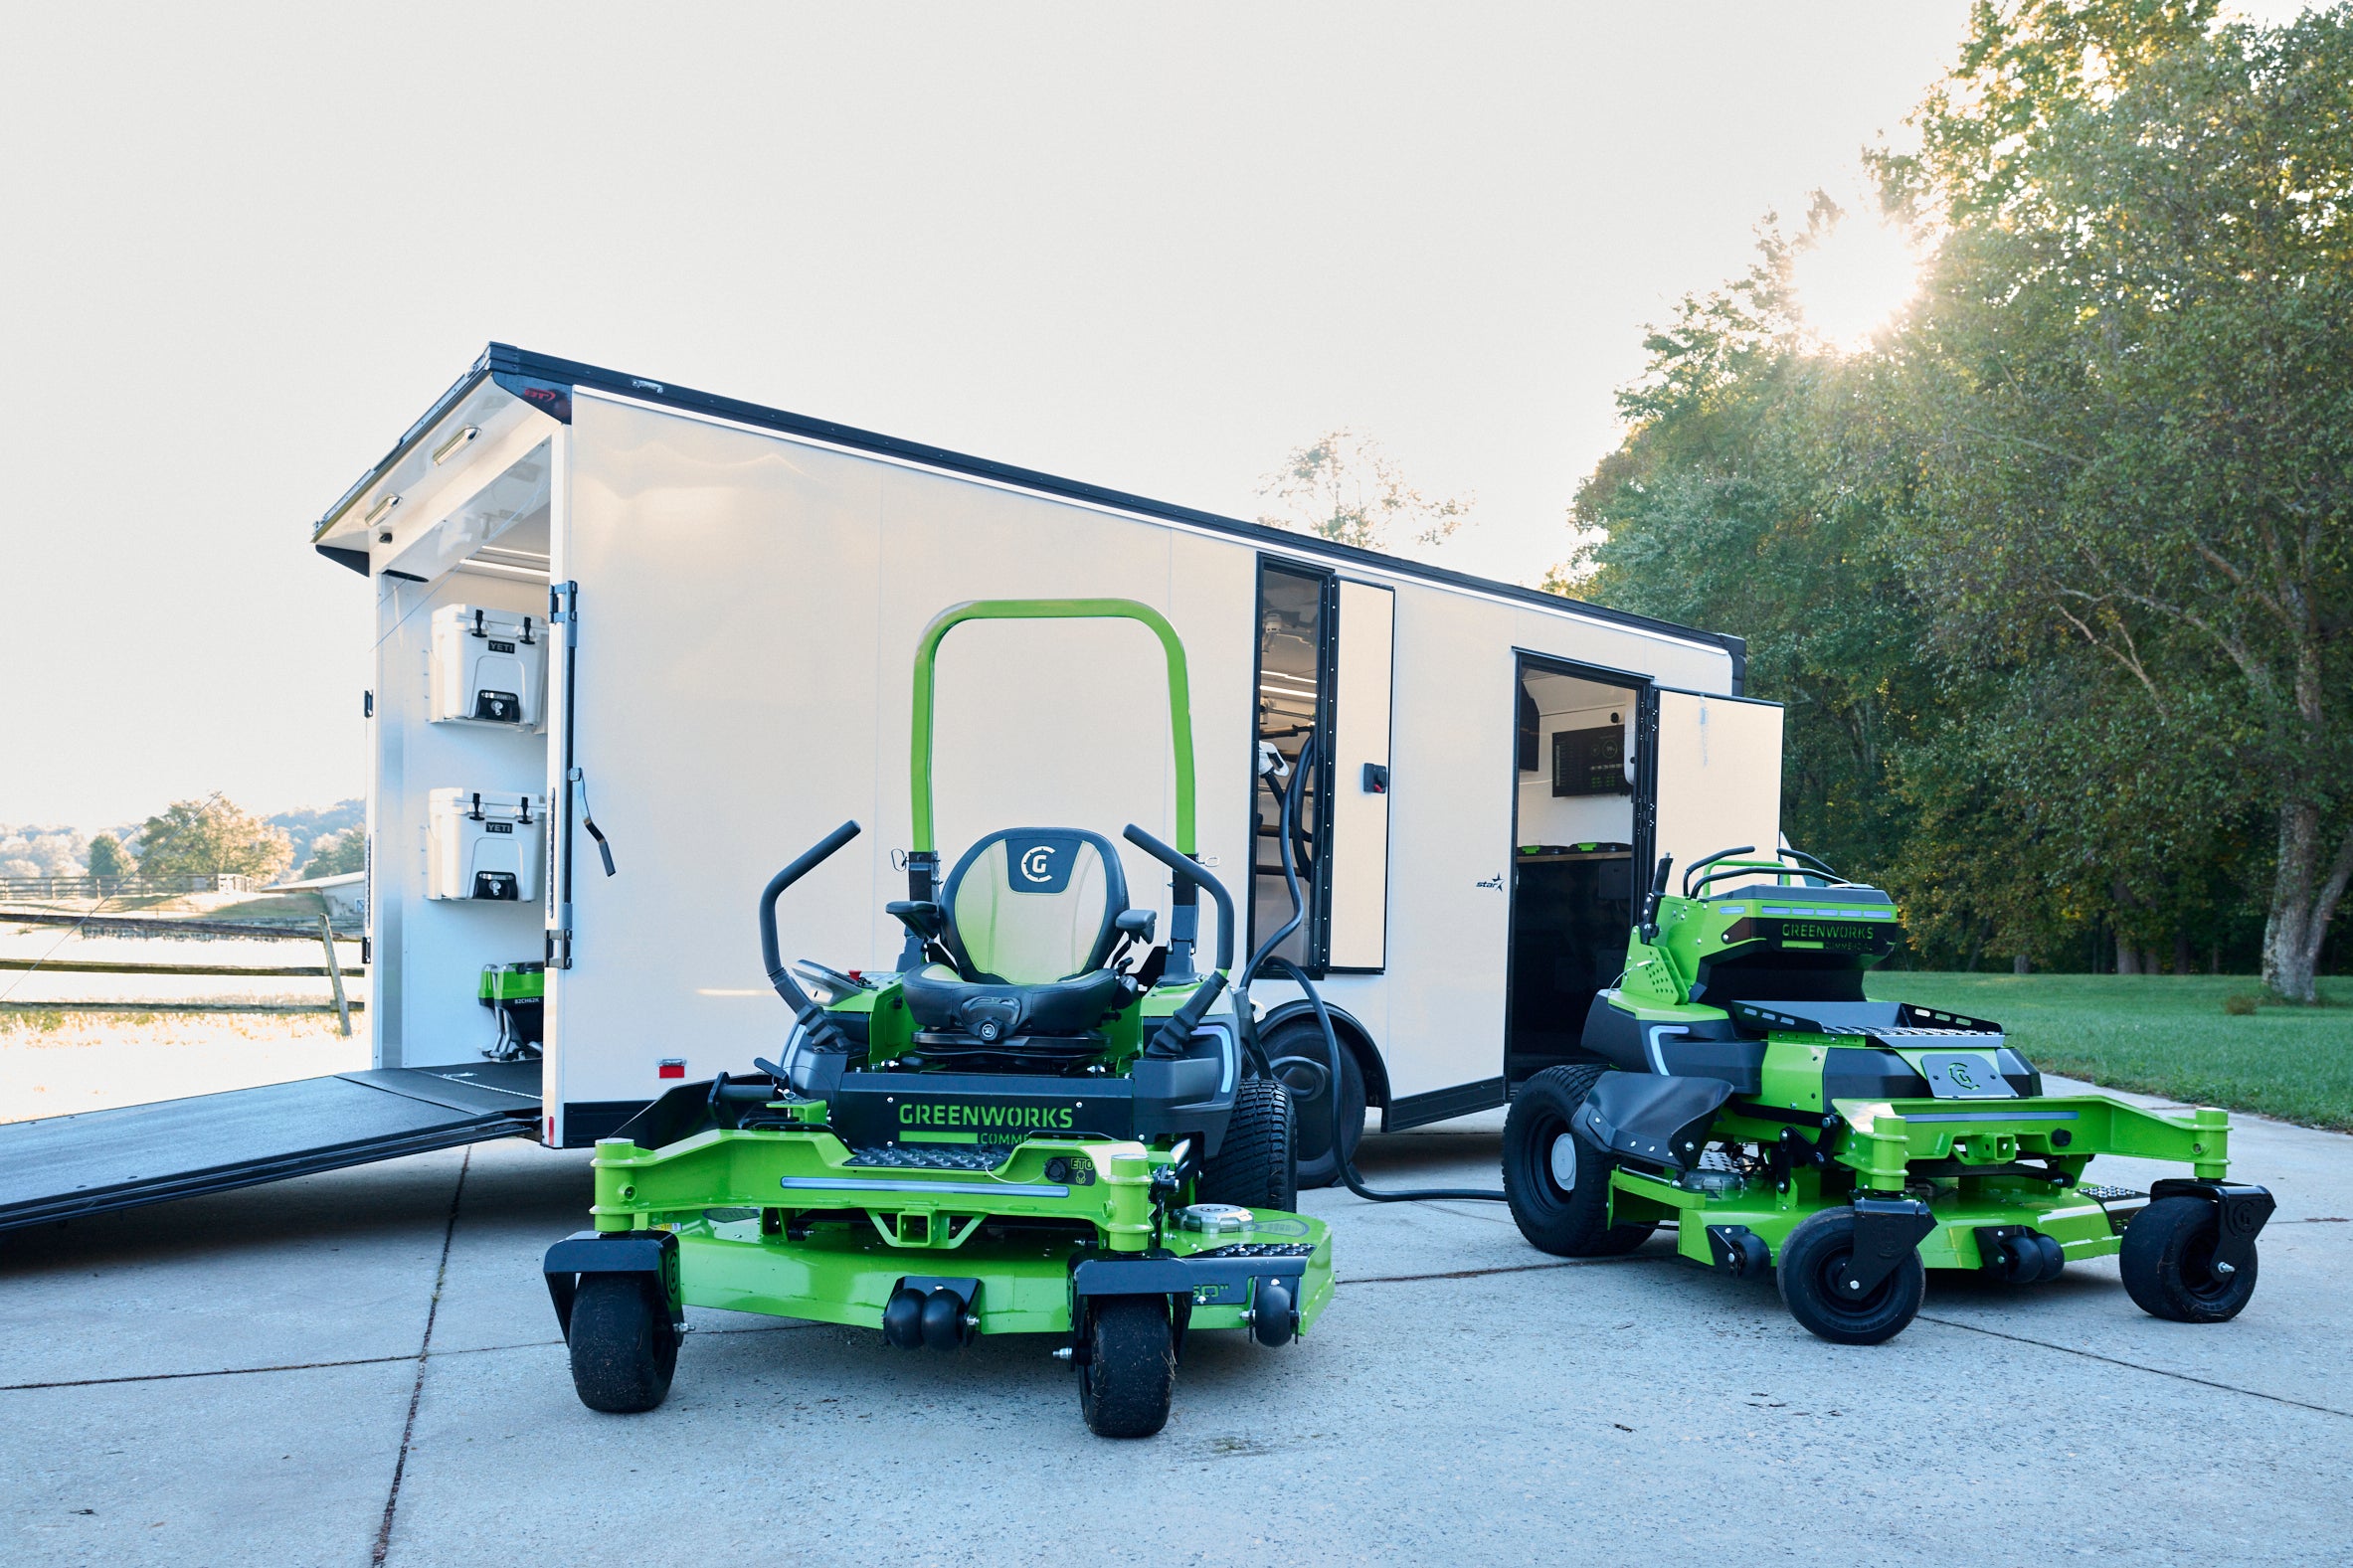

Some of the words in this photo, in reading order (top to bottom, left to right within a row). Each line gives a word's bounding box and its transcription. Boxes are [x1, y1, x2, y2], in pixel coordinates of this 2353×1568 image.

[490, 642, 513, 652] YETI
[487, 823, 510, 832] YETI
[1782, 924, 1874, 940] GREENWORKS
[899, 1104, 1073, 1129] GREENWORKS
[1070, 1158, 1094, 1171] ETO
